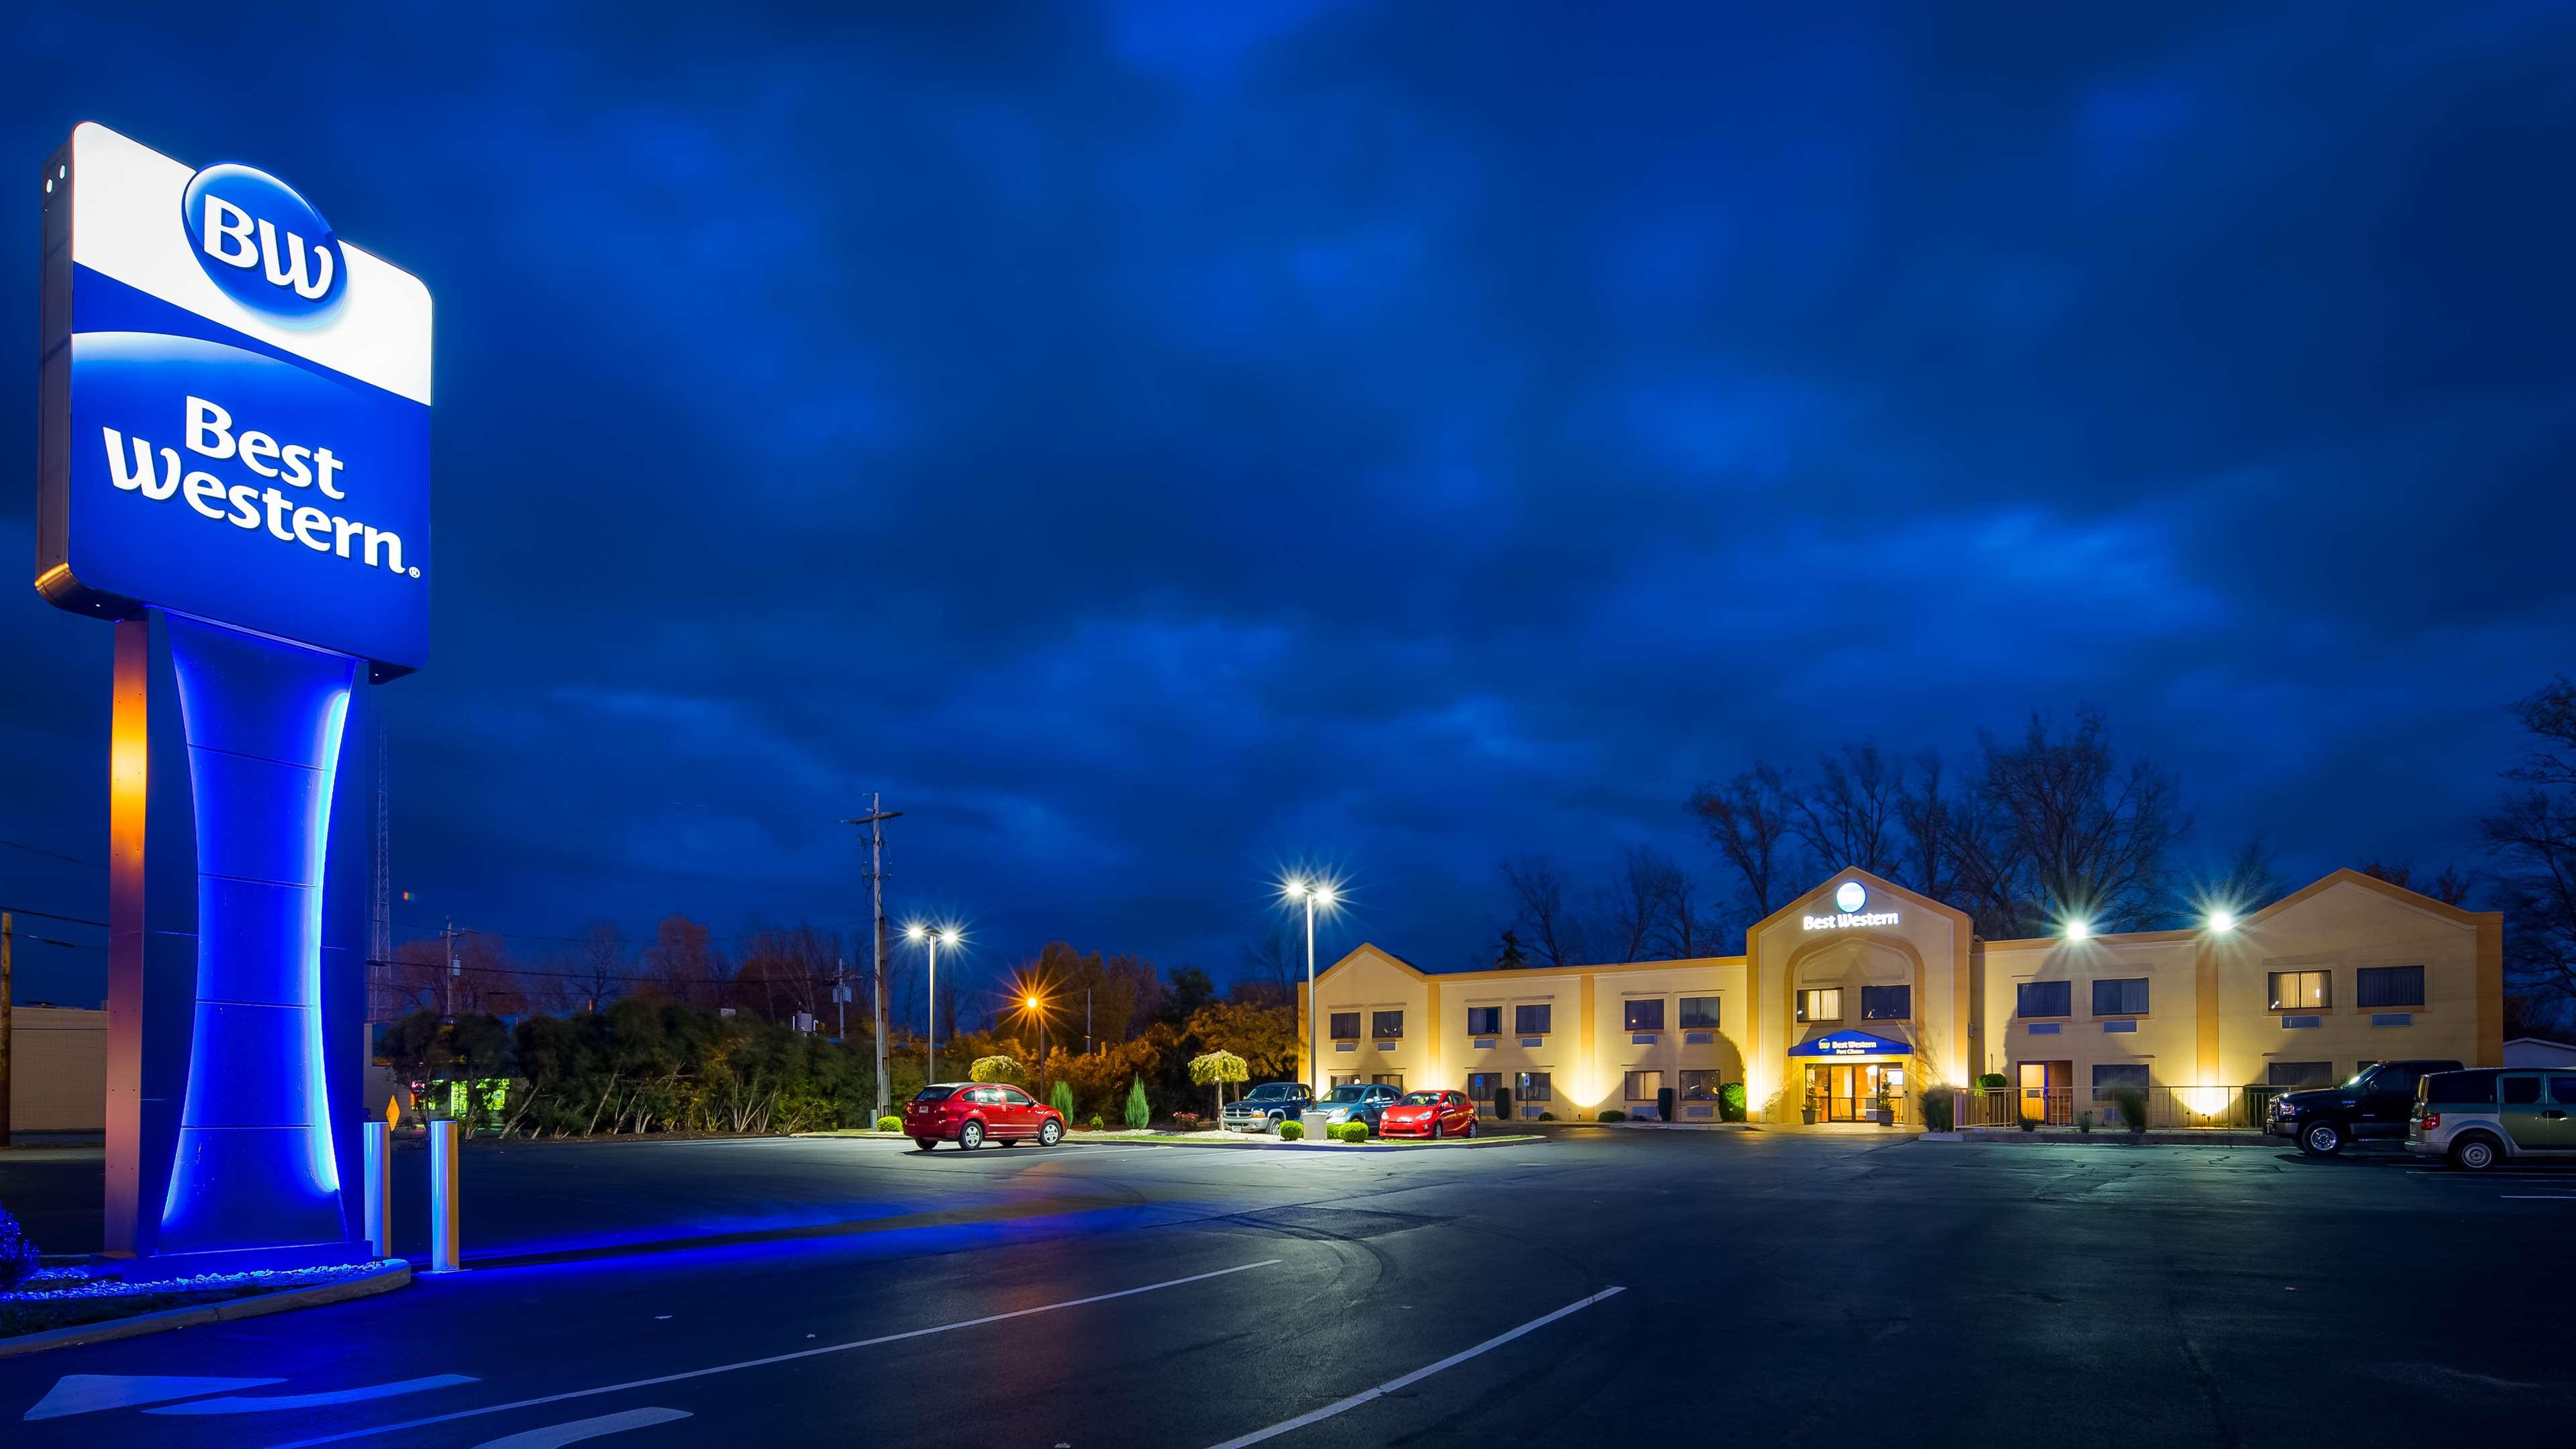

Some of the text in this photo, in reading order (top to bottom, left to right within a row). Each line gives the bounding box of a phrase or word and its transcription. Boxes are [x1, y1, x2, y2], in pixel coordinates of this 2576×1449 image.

[203, 193, 334, 299] BW
[185, 395, 346, 500] Best
[1803, 912, 1899, 930] Best Western
